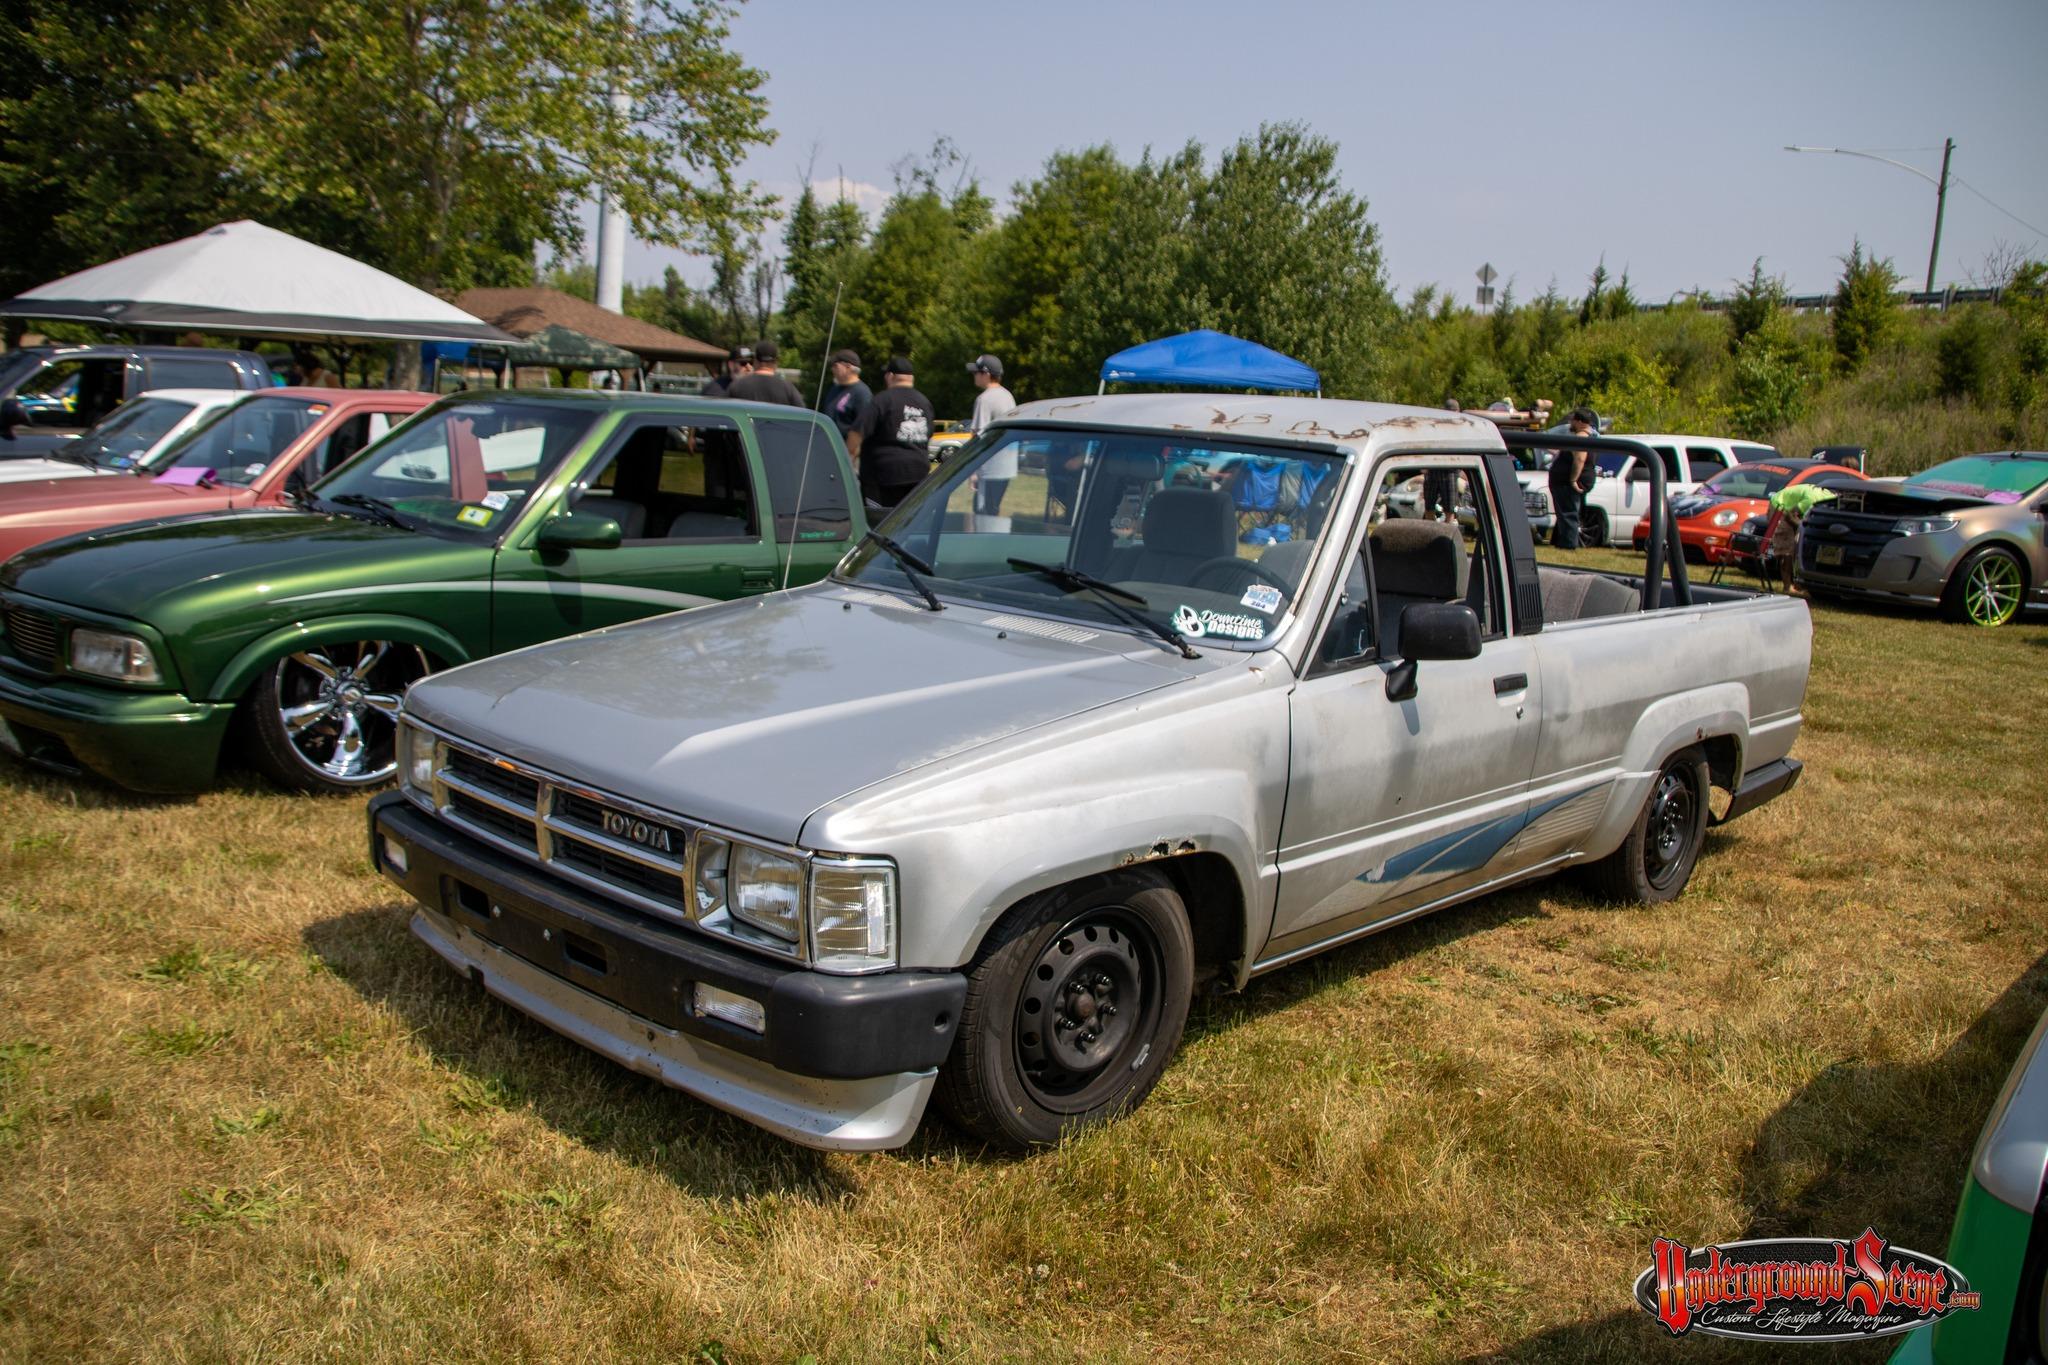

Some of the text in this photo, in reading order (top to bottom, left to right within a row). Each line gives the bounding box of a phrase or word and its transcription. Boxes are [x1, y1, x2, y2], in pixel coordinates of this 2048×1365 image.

[1199, 609, 1262, 628] Downtime
[1207, 620, 1264, 640] Designs
[601, 808, 671, 852] TOYOTA
